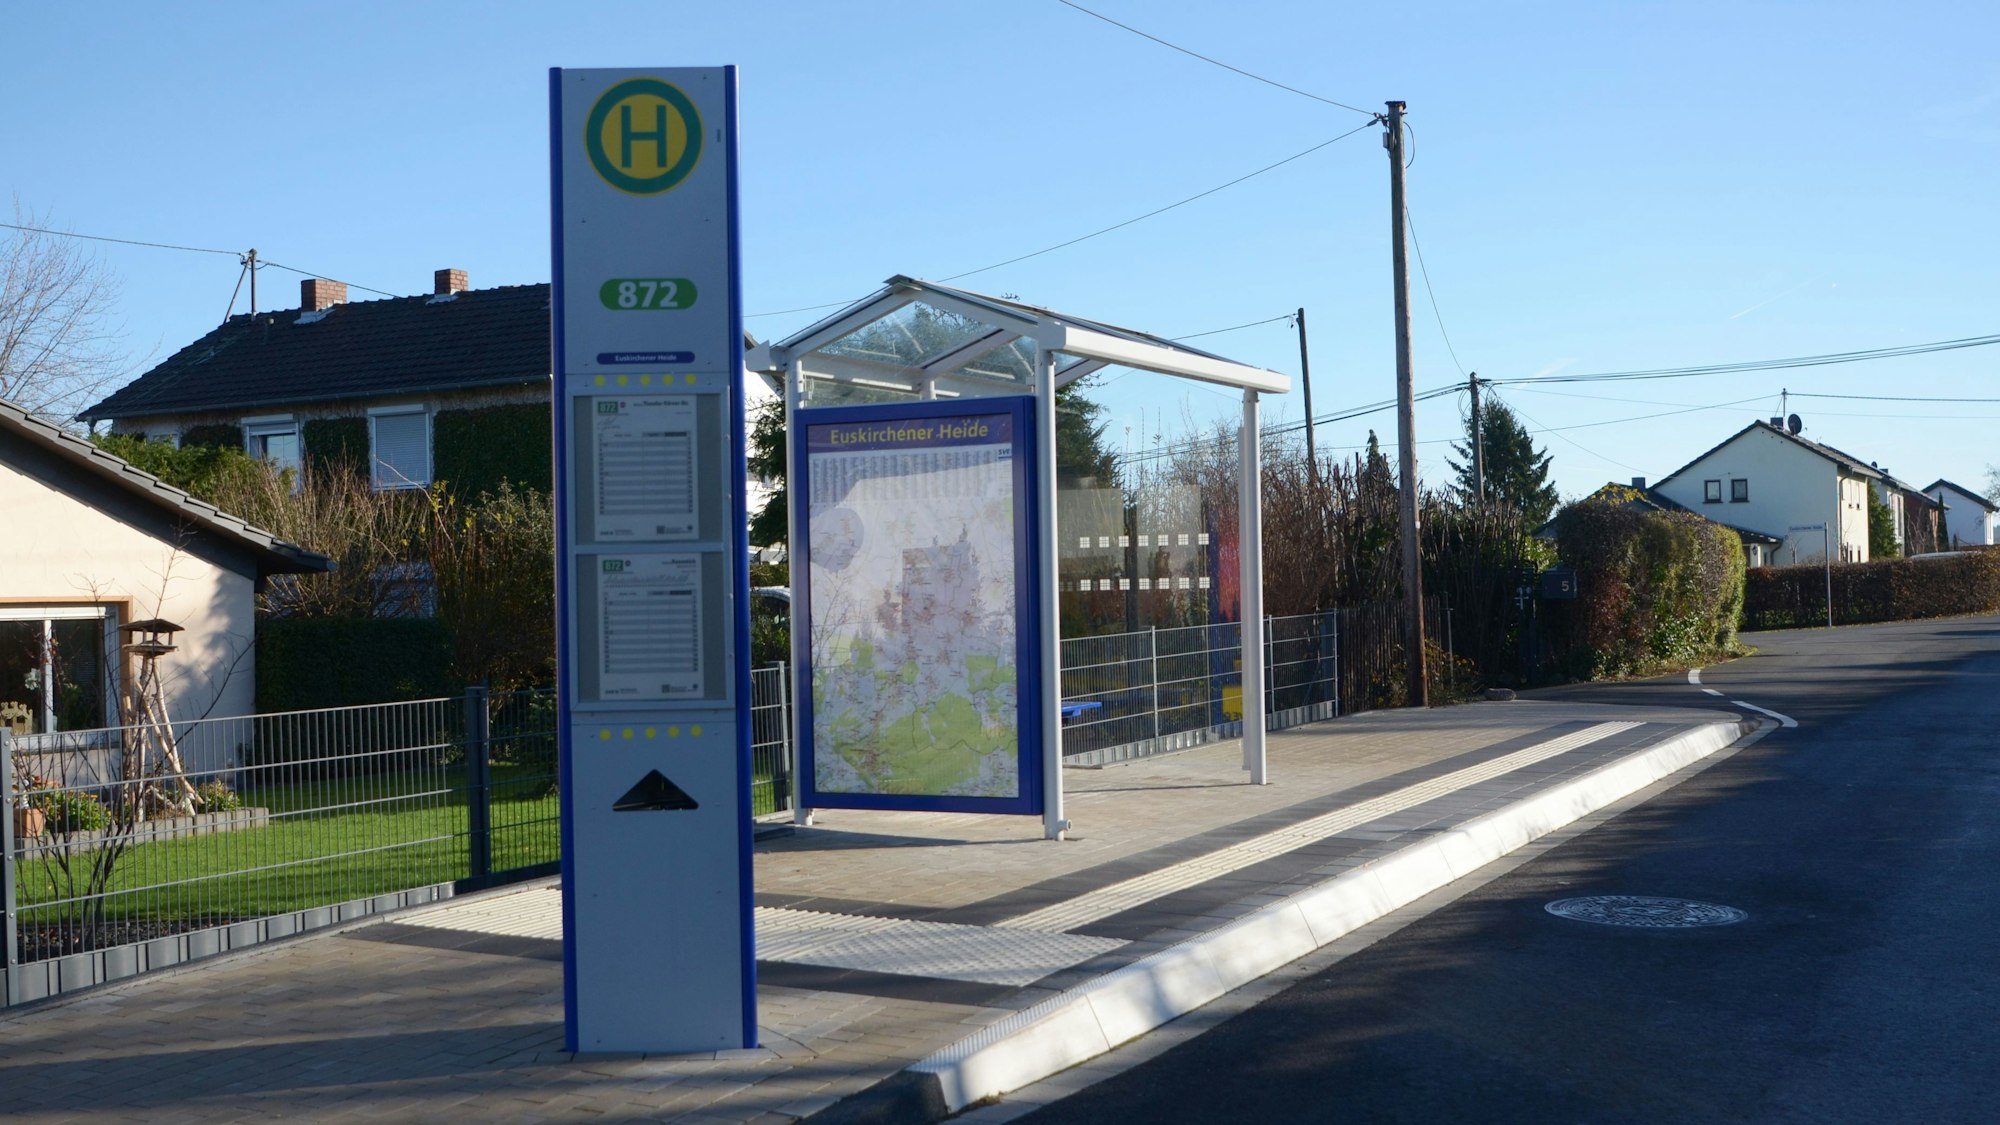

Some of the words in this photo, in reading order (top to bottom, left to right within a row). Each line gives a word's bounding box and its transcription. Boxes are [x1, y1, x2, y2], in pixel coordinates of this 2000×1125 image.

[620, 104, 667, 168] H
[617, 281, 678, 308] 872
[615, 354, 656, 362] Euskirchener
[599, 402, 616, 412] 872
[830, 426, 934, 445] Euskirchener
[939, 422, 989, 440] Heide
[604, 561, 621, 571] 872
[1561, 580, 1569, 592] 5
